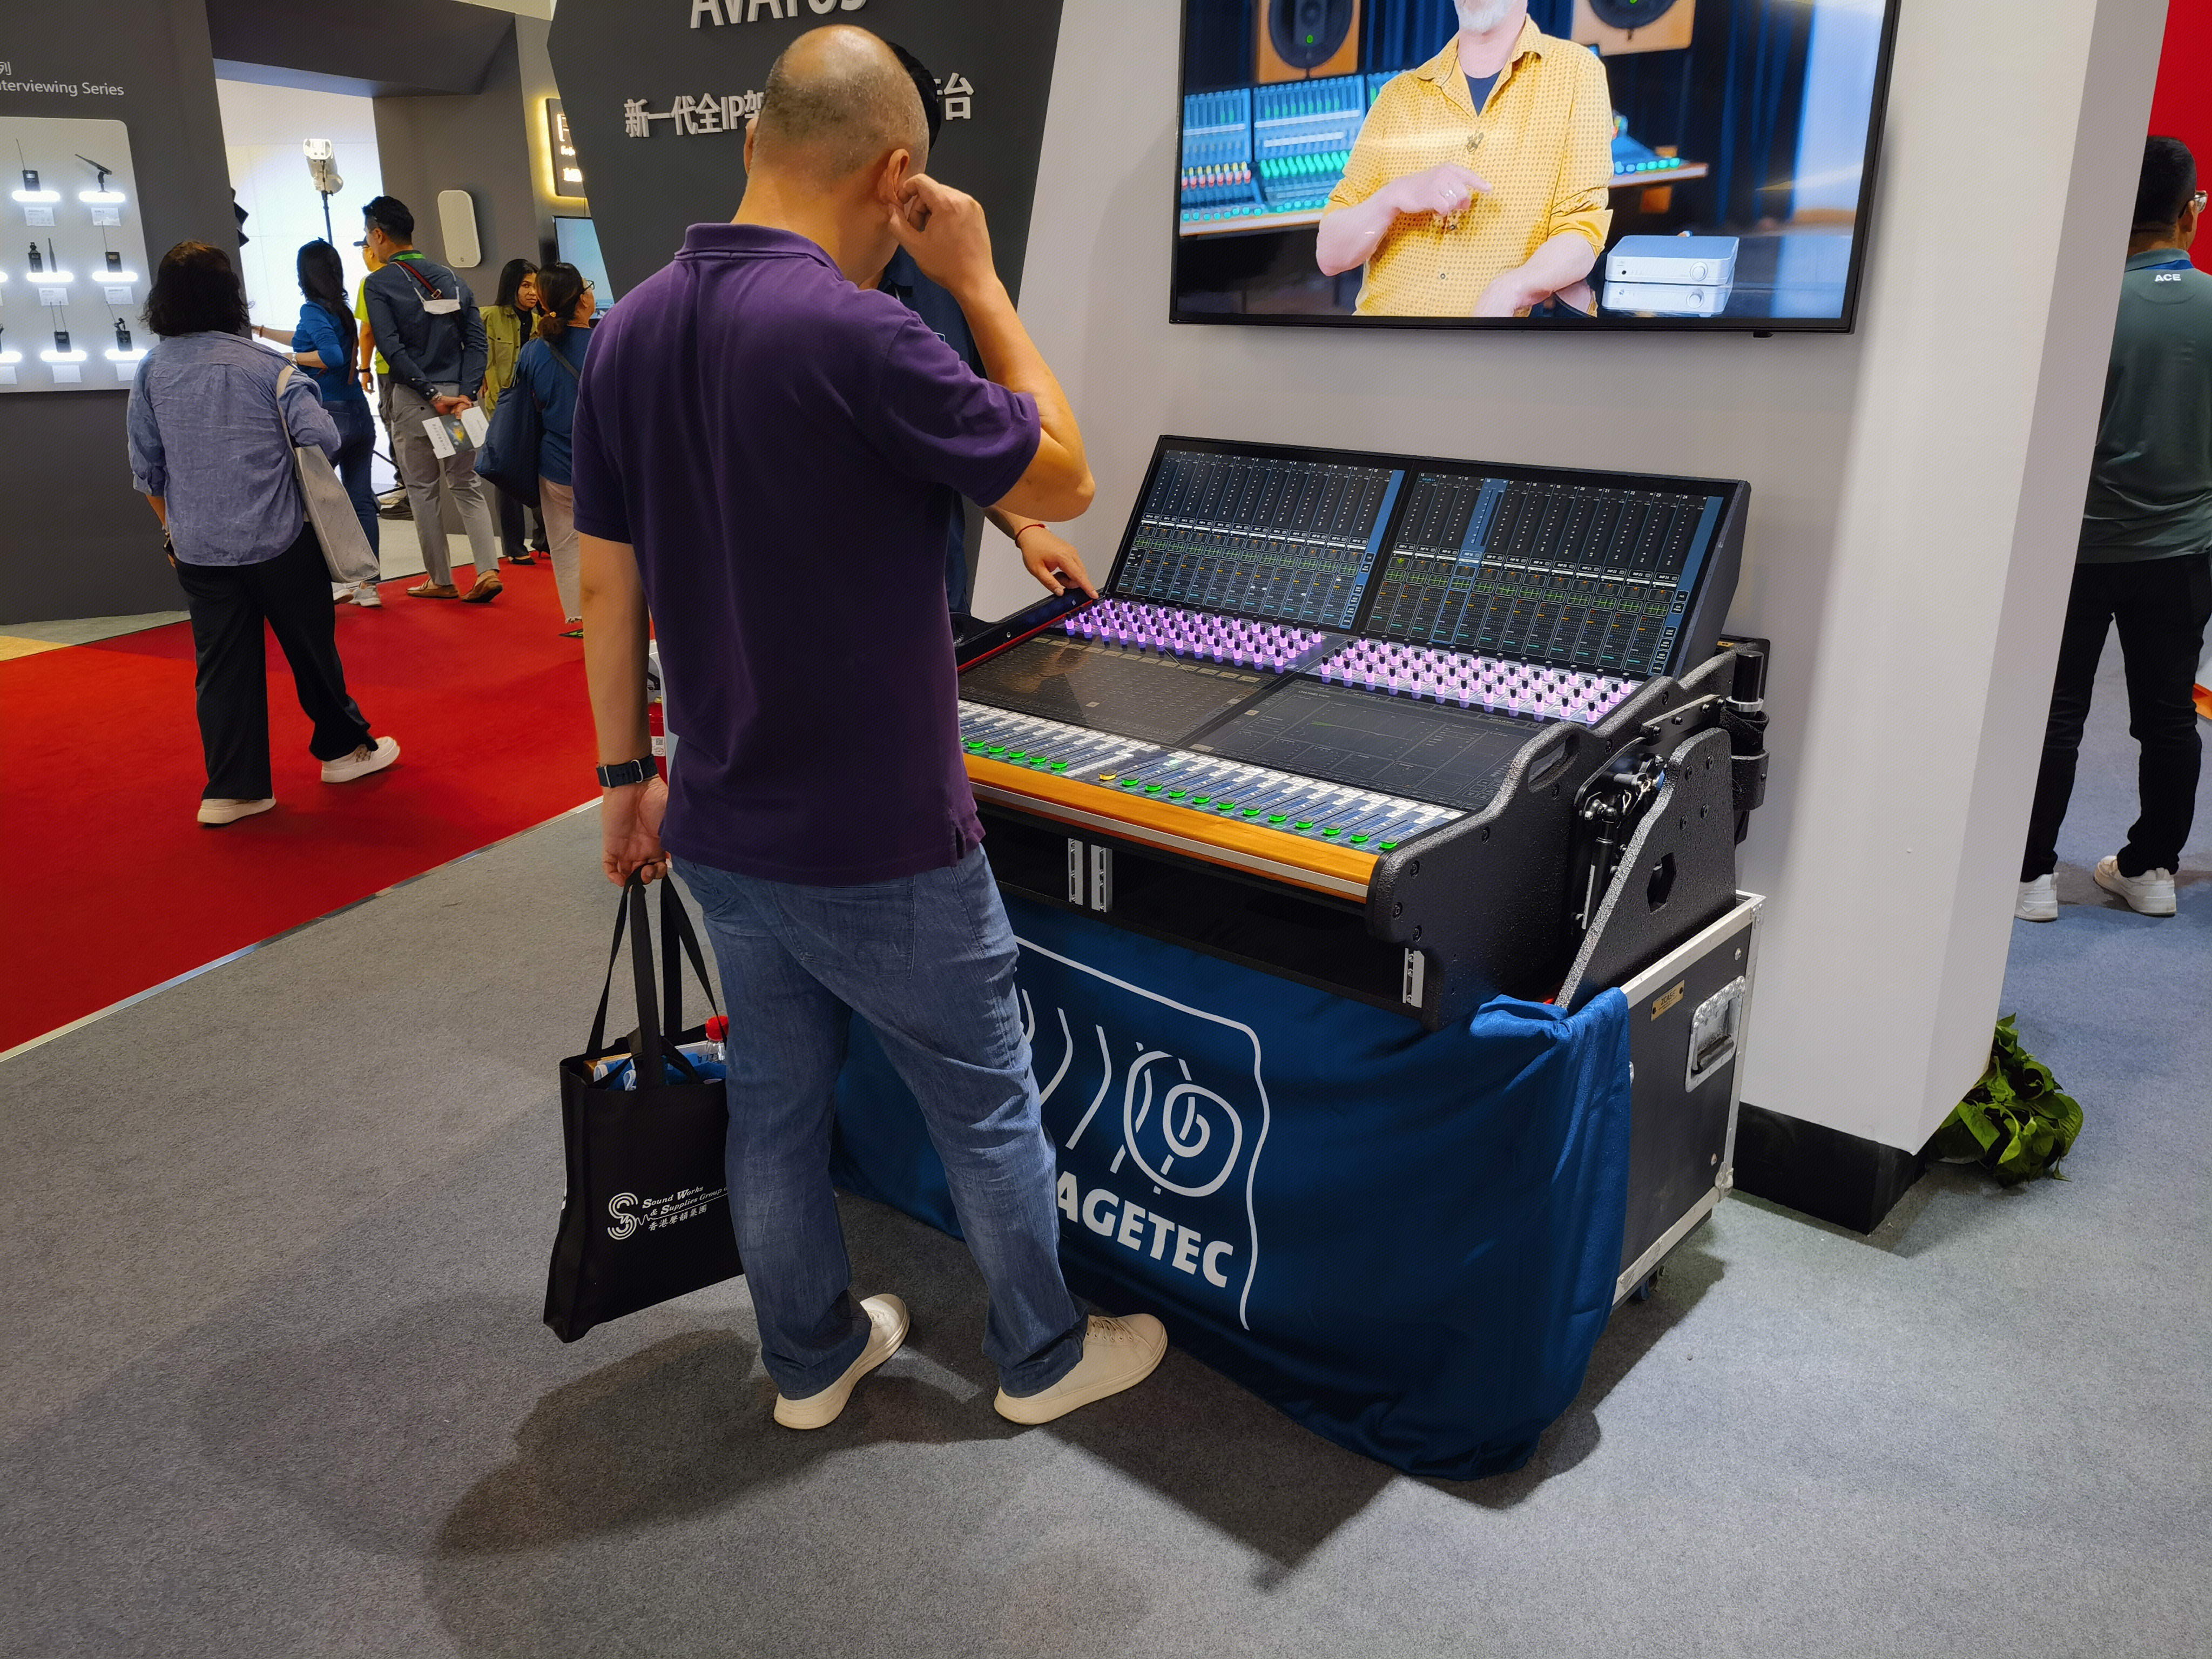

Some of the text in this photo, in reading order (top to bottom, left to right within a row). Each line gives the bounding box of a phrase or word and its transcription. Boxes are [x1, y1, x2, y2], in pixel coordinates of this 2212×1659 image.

[0, 79, 124, 97] terviewing Series
[934, 72, 974, 120] 台
[2154, 274, 2181, 282] ACE
[642, 1186, 704, 1209] Sound Works
[650, 1189, 722, 1216] & Supplies Group
[1057, 1170, 1233, 1289] AGETEC
